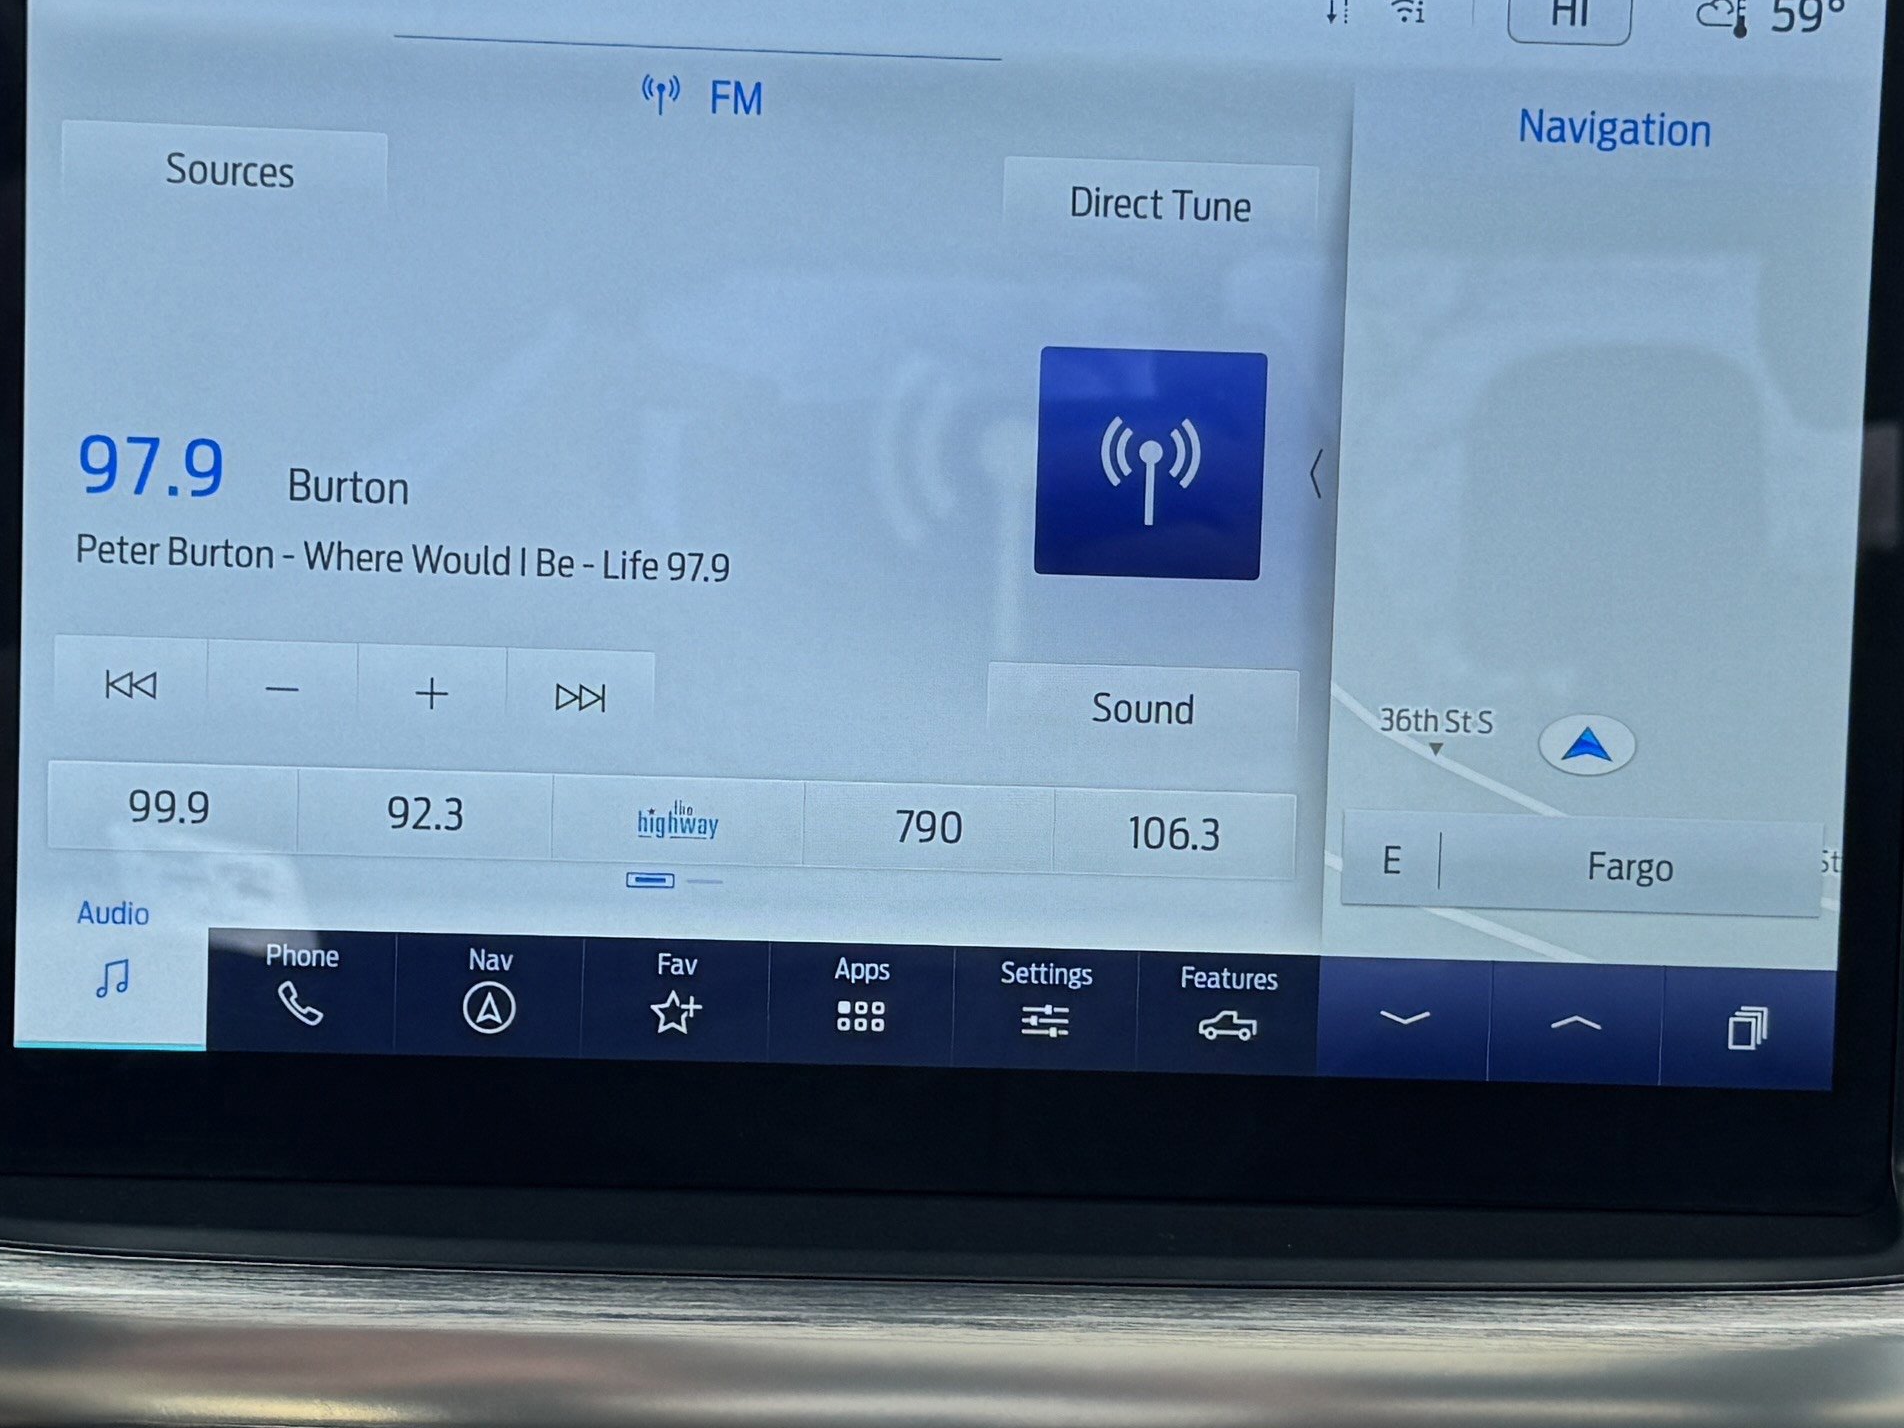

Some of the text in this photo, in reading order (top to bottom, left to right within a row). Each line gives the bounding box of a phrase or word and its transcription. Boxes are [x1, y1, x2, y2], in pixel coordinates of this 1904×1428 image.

[712, 80, 761, 115] FM
[1521, 109, 1710, 151] Navigation
[167, 153, 293, 188] Sources
[1072, 186, 1250, 222] Direct Tune
[80, 435, 222, 497] 97.9
[290, 468, 407, 504] Burton
[78, 534, 160, 565] Peter
[169, 537, 273, 568] Burton
[304, 541, 403, 572] Where
[412, 544, 510, 575] Would
[537, 548, 574, 577] Be
[604, 550, 658, 580] Life
[668, 552, 729, 582] 97.9
[1093, 693, 1193, 724] Sound
[1381, 707, 1493, 735] 36th St S
[130, 790, 208, 823] 99.9
[388, 796, 462, 830] 92.3
[637, 809, 720, 840] highway
[897, 810, 962, 844] 790
[1130, 816, 1219, 851] 106.3
[1384, 846, 1401, 874] E
[1590, 852, 1673, 887] Fargo
[78, 901, 148, 925] Audio
[265, 942, 340, 970] Phone
[470, 948, 513, 970] Nav
[659, 953, 697, 975] Fav
[835, 957, 890, 984] Apps
[1001, 961, 1092, 989] Settings
[1182, 966, 1278, 990] Features
